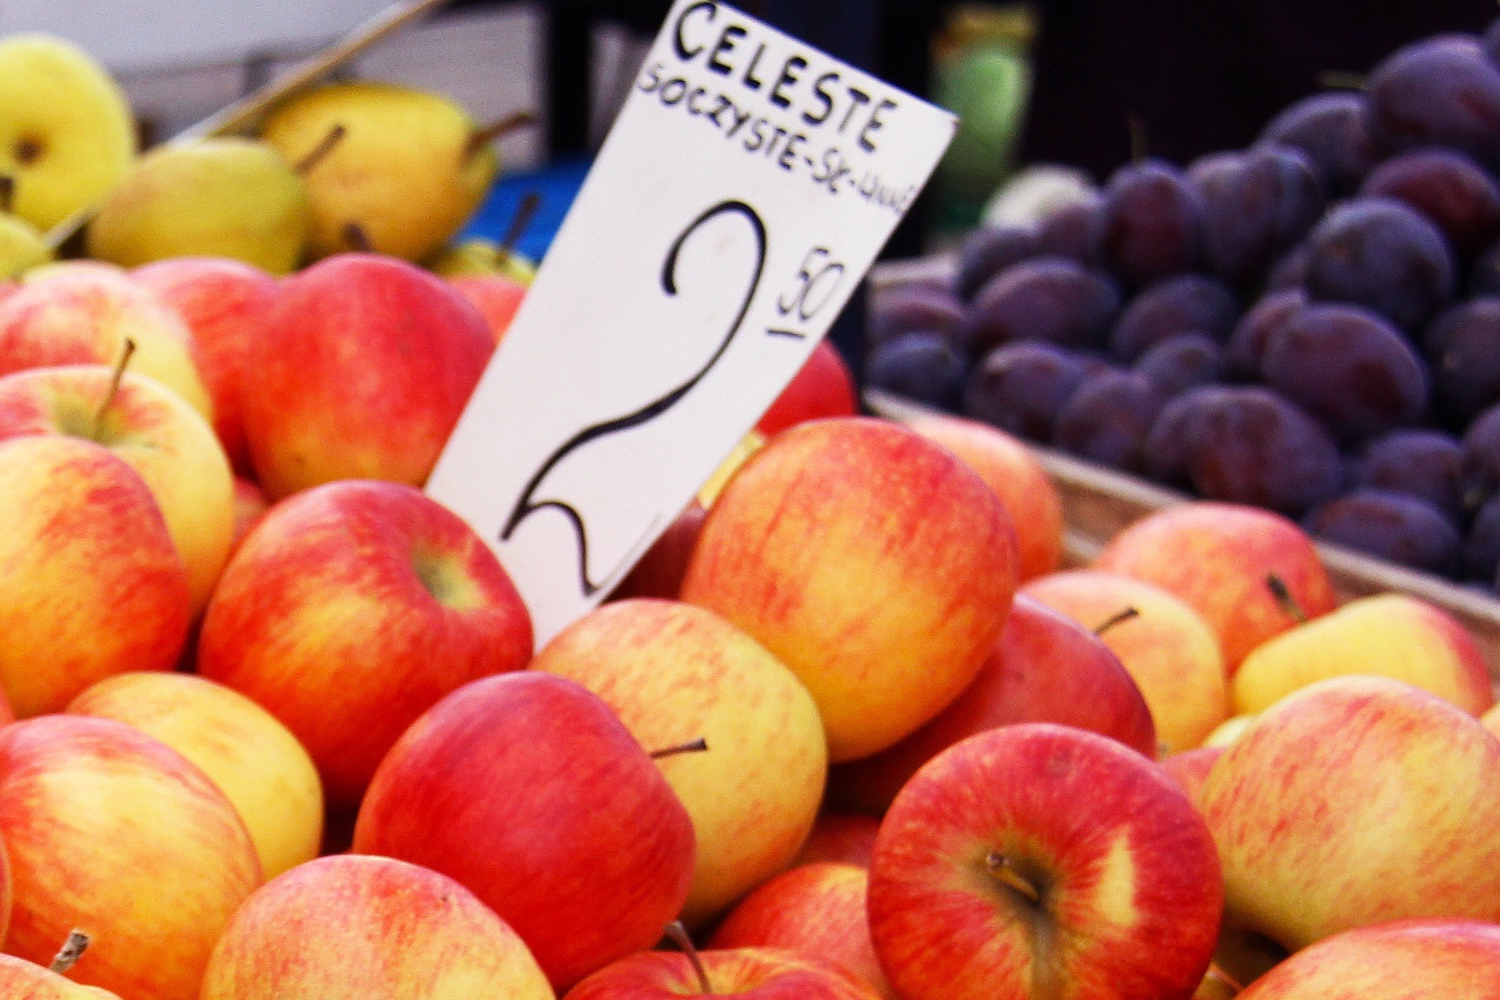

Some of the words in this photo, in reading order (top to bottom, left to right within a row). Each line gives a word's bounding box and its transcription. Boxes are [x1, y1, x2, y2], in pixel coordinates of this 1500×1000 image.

[673, 2, 897, 153] CELESTE
[500, 199, 767, 597] 2
[777, 246, 845, 322] 50
